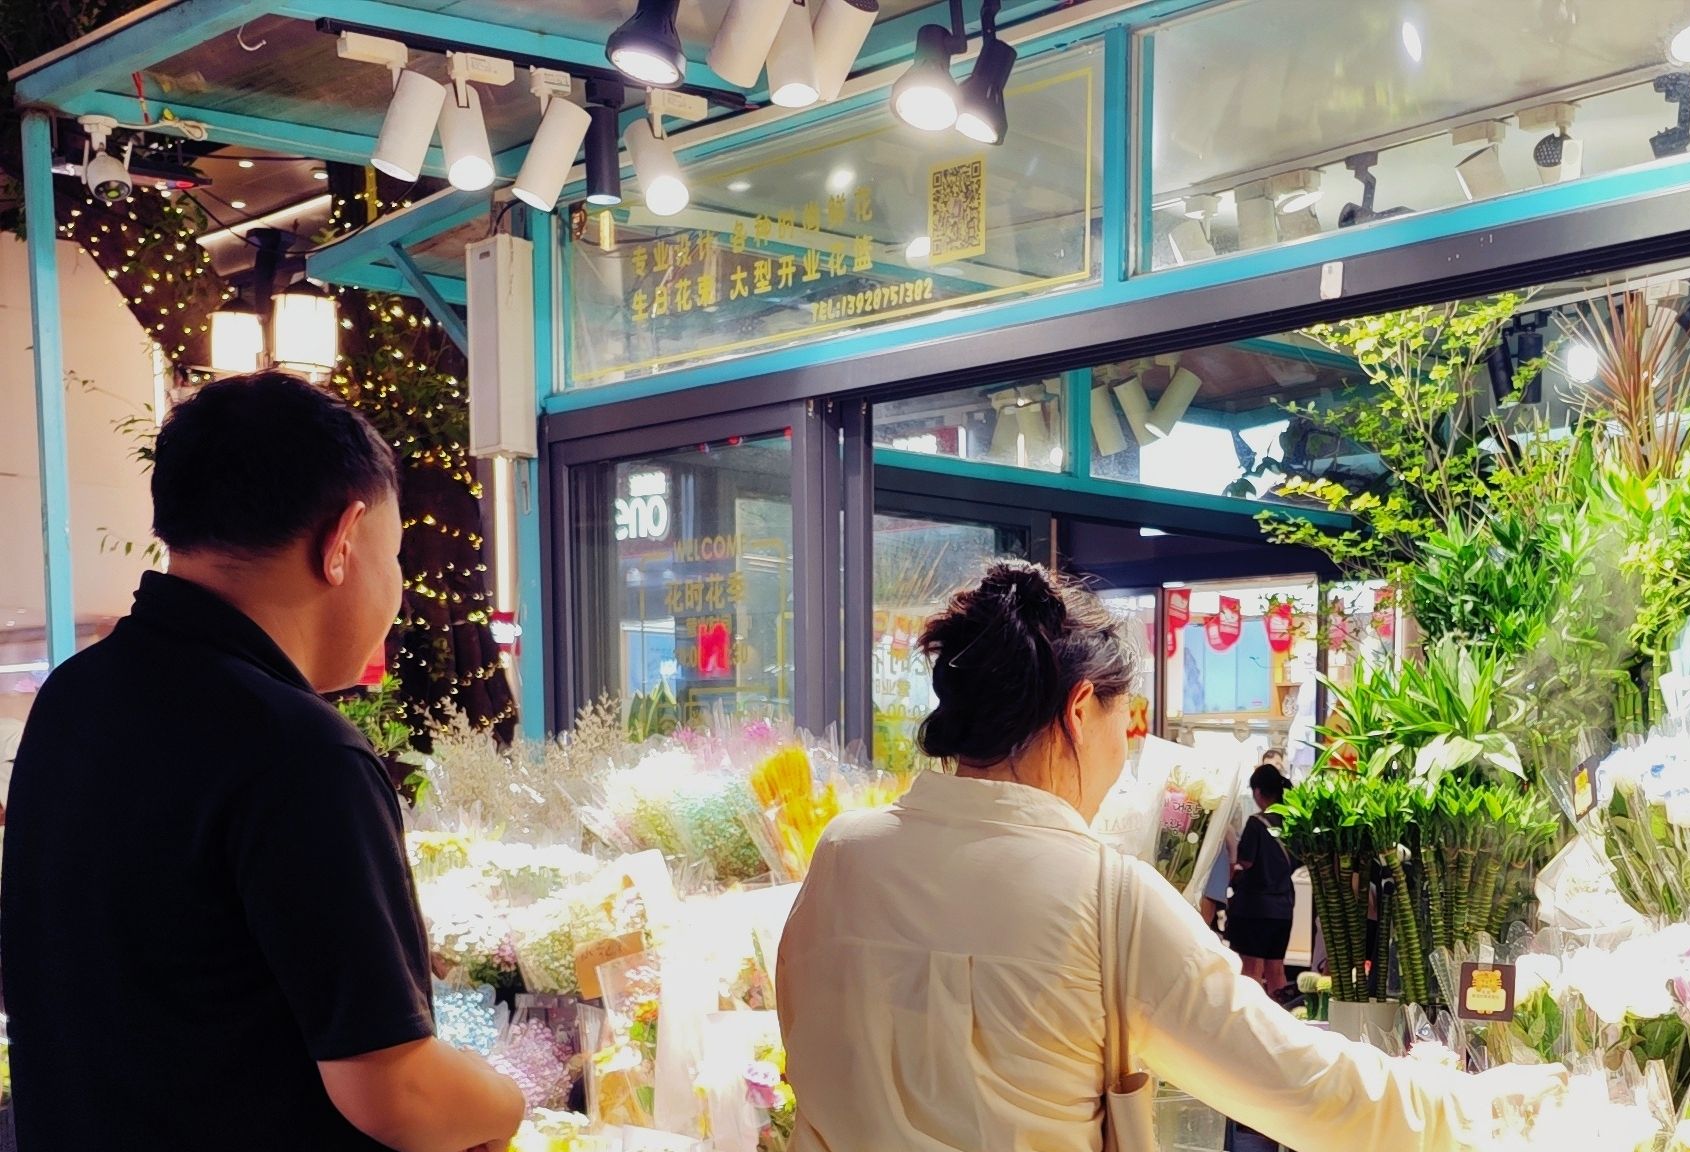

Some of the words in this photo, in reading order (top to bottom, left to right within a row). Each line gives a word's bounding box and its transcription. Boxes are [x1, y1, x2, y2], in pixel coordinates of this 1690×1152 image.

[632, 231, 715, 277] 专业设计
[632, 273, 717, 322] 生日花束
[730, 235, 873, 301] 大型开业花篮
